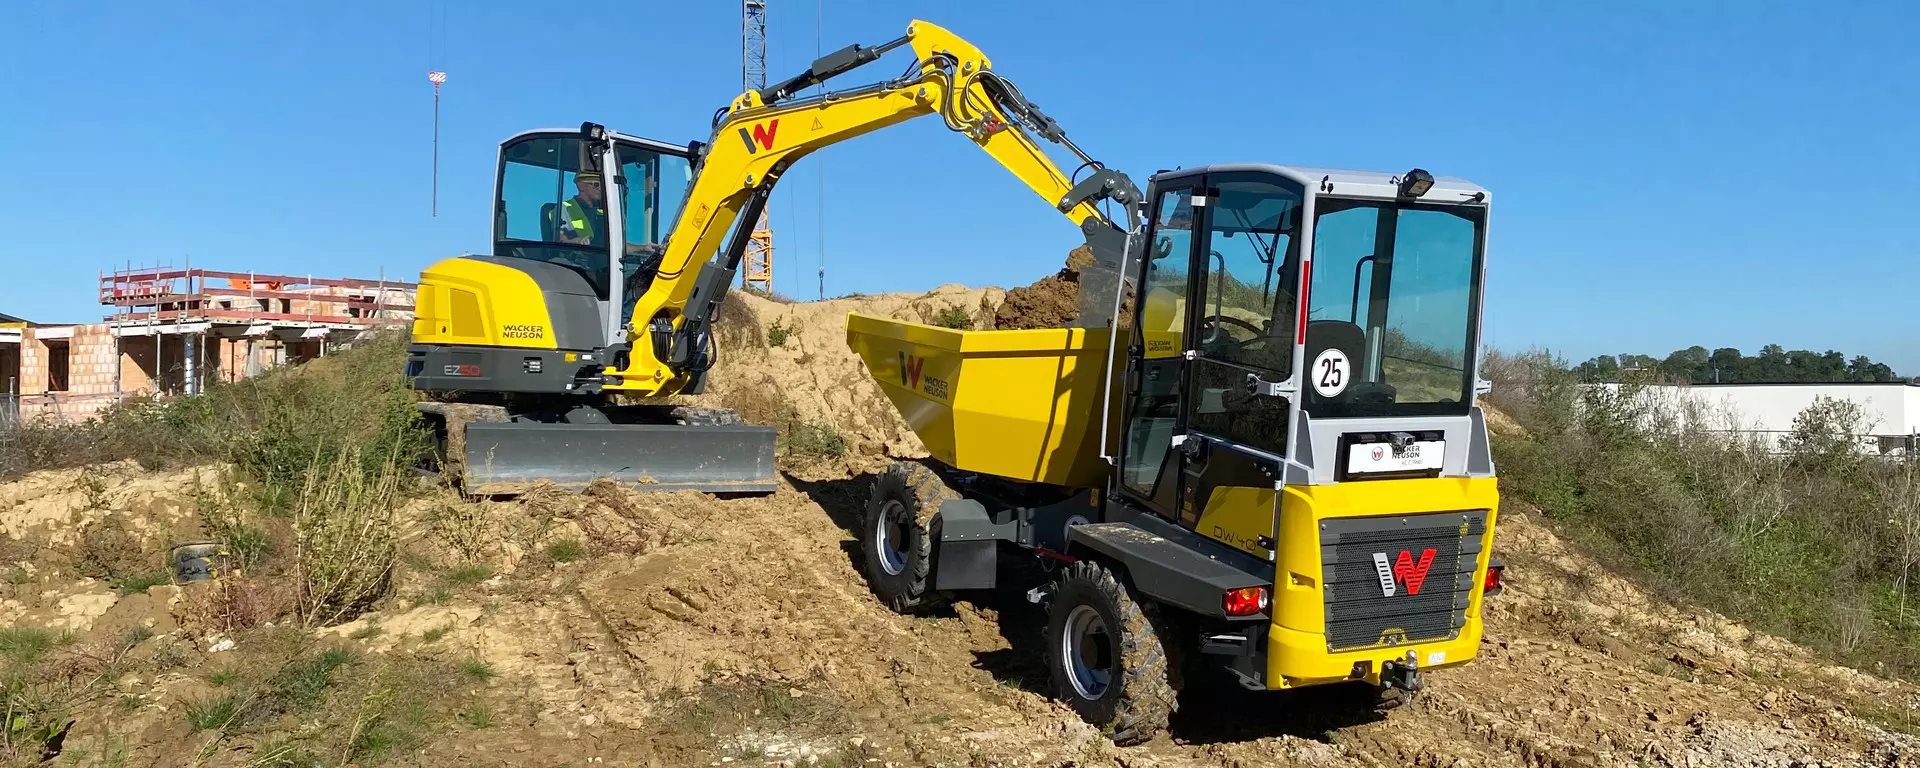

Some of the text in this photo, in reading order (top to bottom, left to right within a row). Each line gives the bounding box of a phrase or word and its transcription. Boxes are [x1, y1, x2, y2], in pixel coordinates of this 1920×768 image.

[1321, 358, 1342, 387] 25
[925, 375, 948, 391] WACKER
[924, 385, 948, 400] NEUSON
[1392, 446, 1420, 454] WACKER
